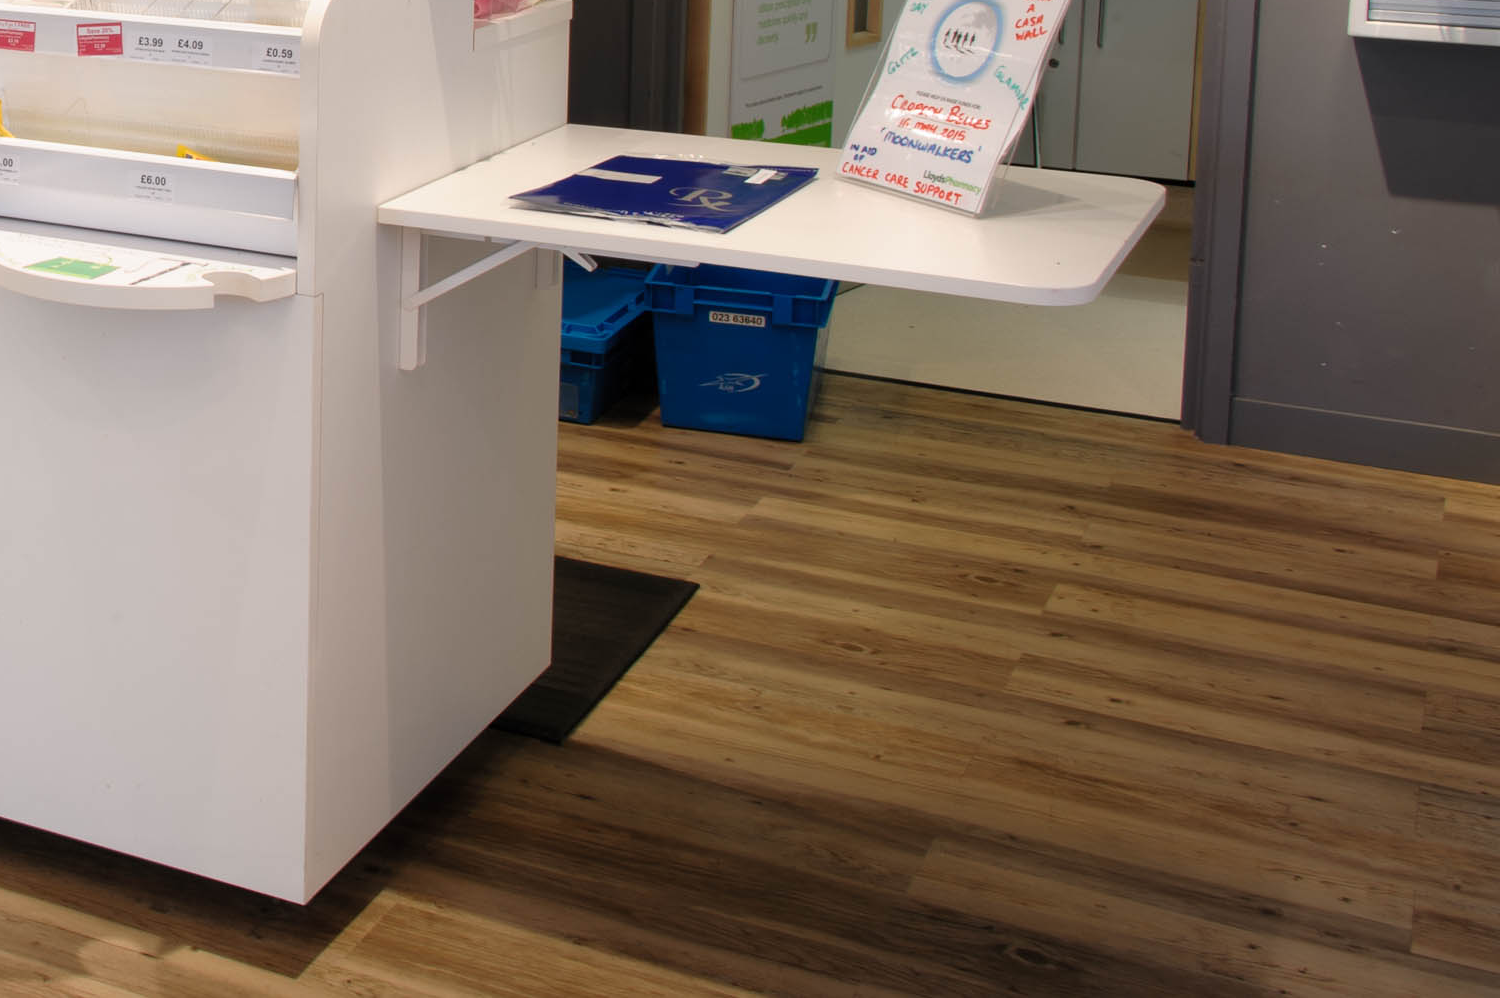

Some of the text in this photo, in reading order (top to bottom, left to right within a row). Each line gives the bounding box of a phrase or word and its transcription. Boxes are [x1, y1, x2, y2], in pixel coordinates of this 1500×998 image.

[1026, 3, 1035, 13] A
[1015, 14, 1044, 29] CASH
[1015, 28, 1048, 42] WALL
[138, 36, 163, 48] £3.99
[178, 39, 203, 50] £4.09
[266, 47, 293, 59] £0.59
[940, 127, 966, 141] 2015
[850, 143, 877, 156] IN AID
[141, 174, 166, 186] £6.00
[842, 161, 962, 205] CANCER CARE SUPPORT
[923, 169, 981, 194] LloydsPharmacy
[711, 312, 730, 323] 023
